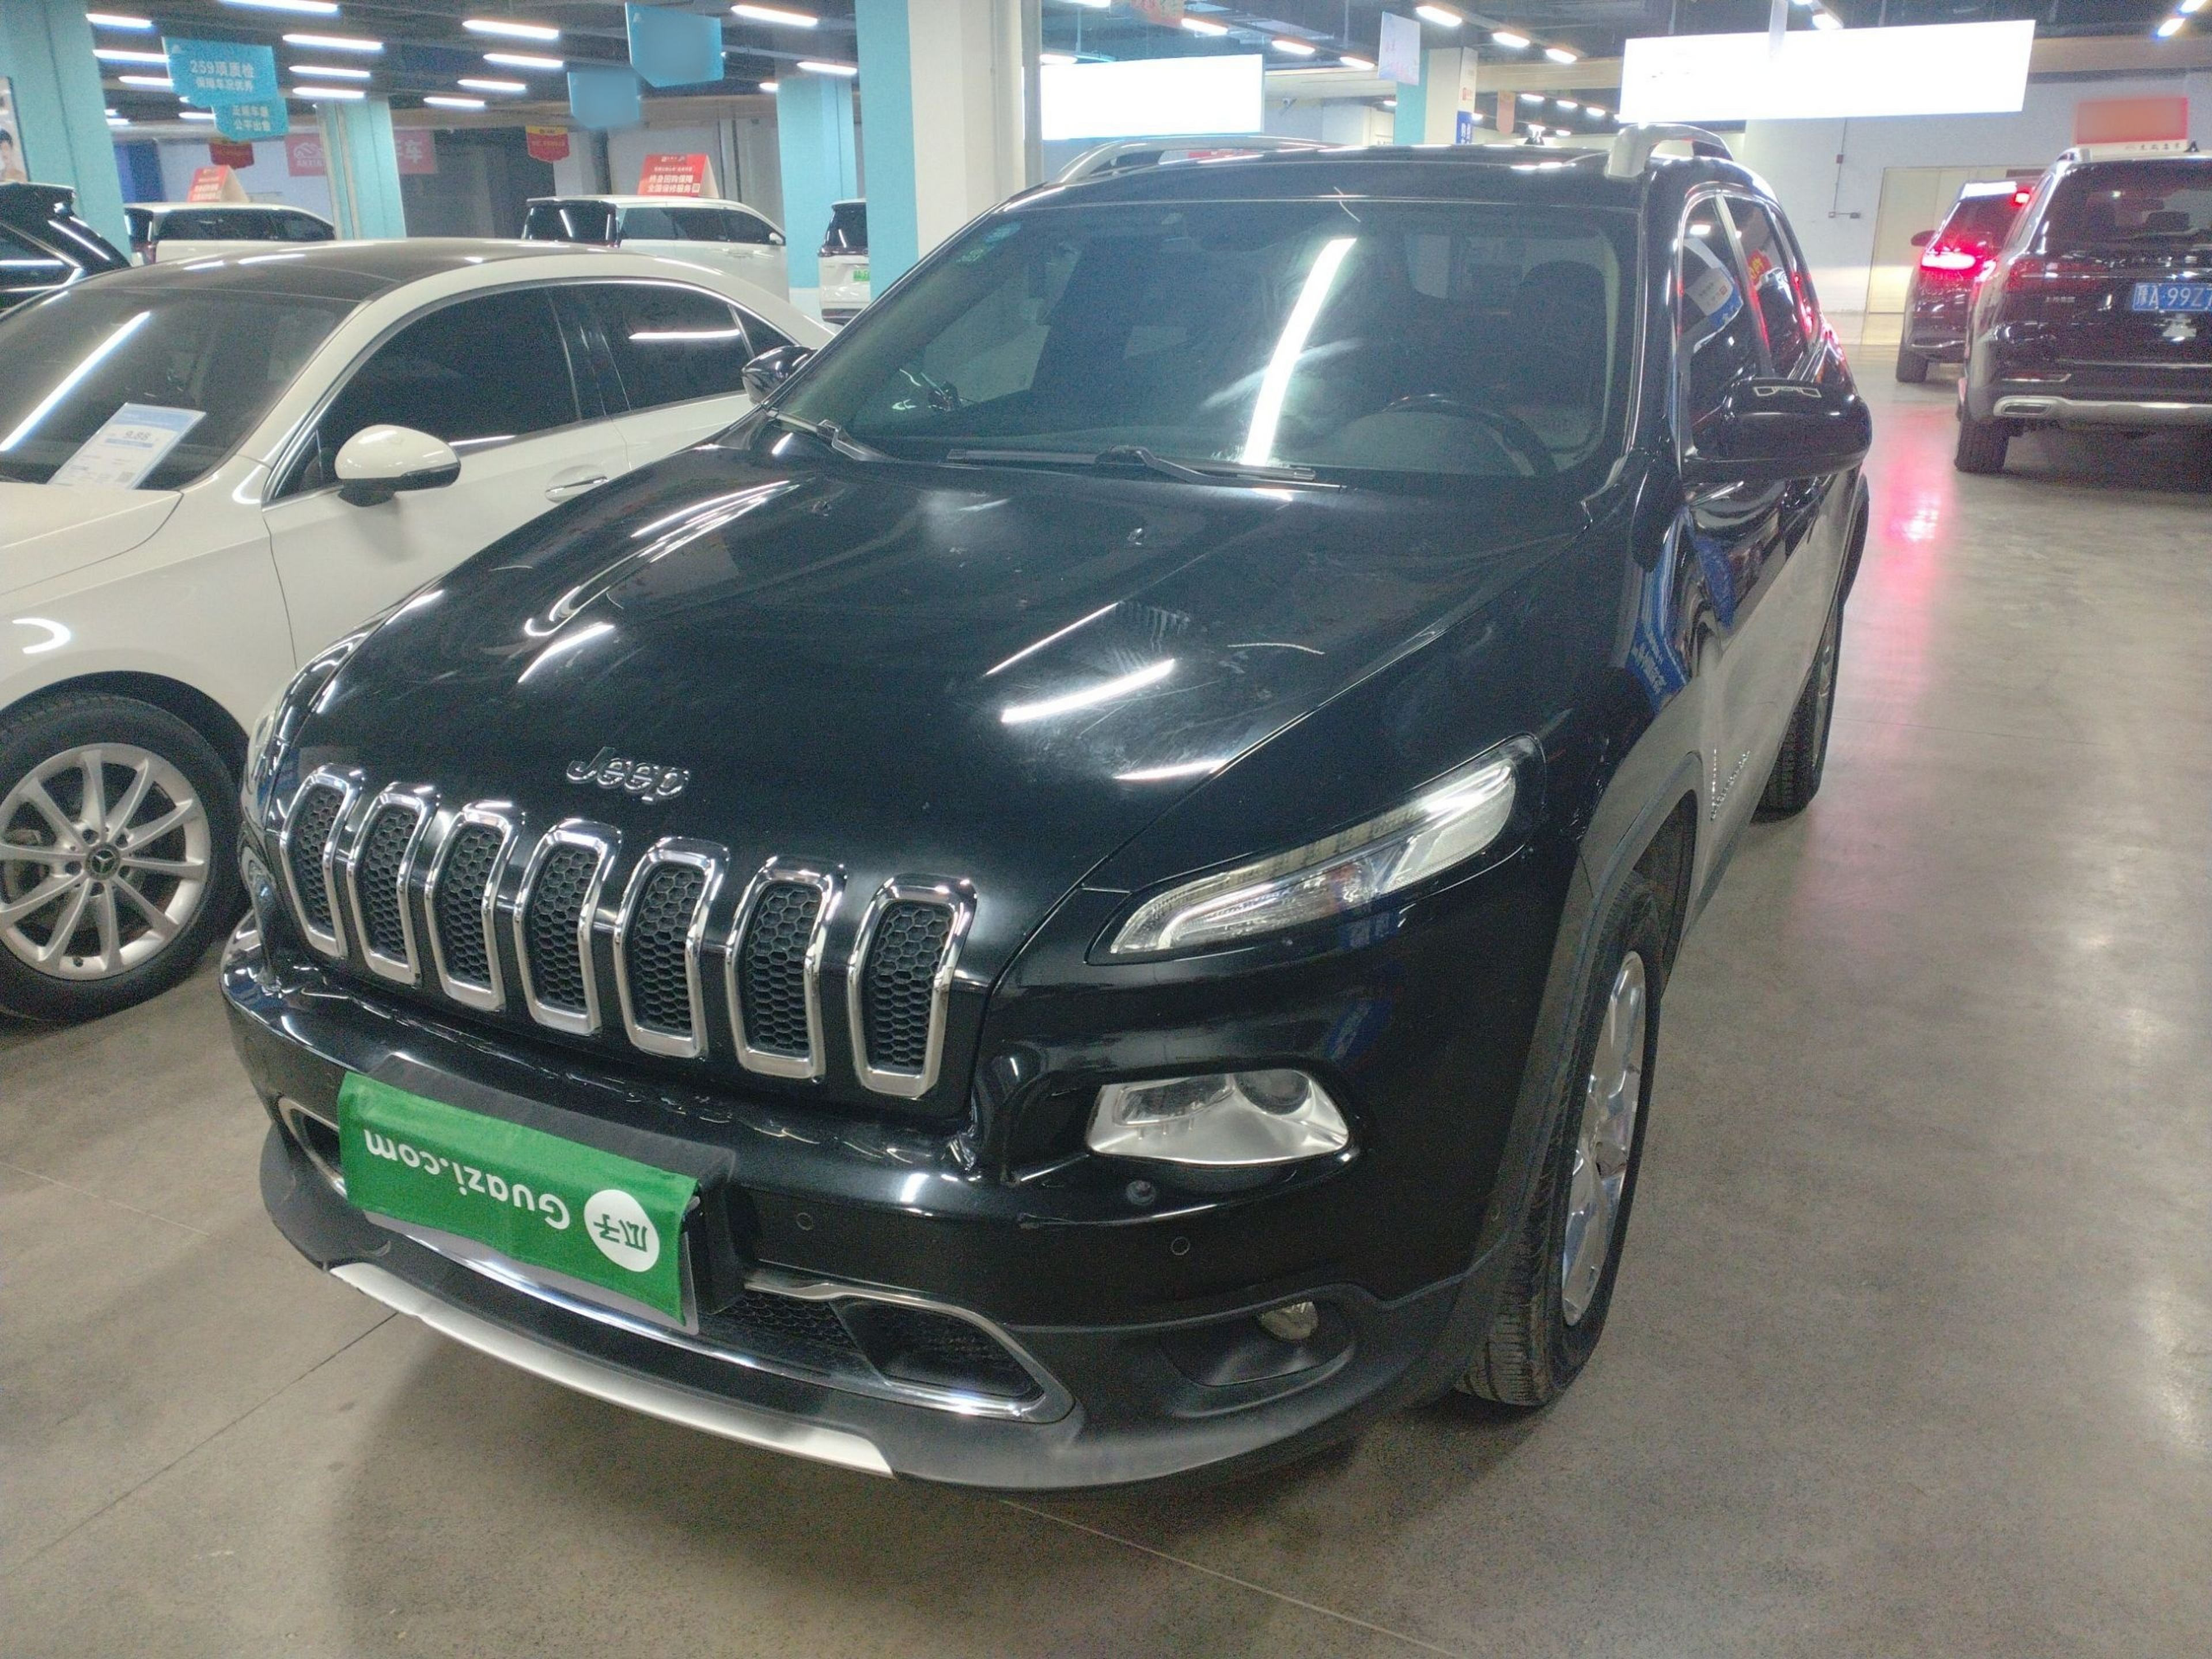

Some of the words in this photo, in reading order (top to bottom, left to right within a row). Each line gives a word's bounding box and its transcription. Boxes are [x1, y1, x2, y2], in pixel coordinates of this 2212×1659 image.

[566, 747, 691, 804] Jeep
[363, 1128, 571, 1230] Guazi.com
[593, 1213, 648, 1253] 瓜子
